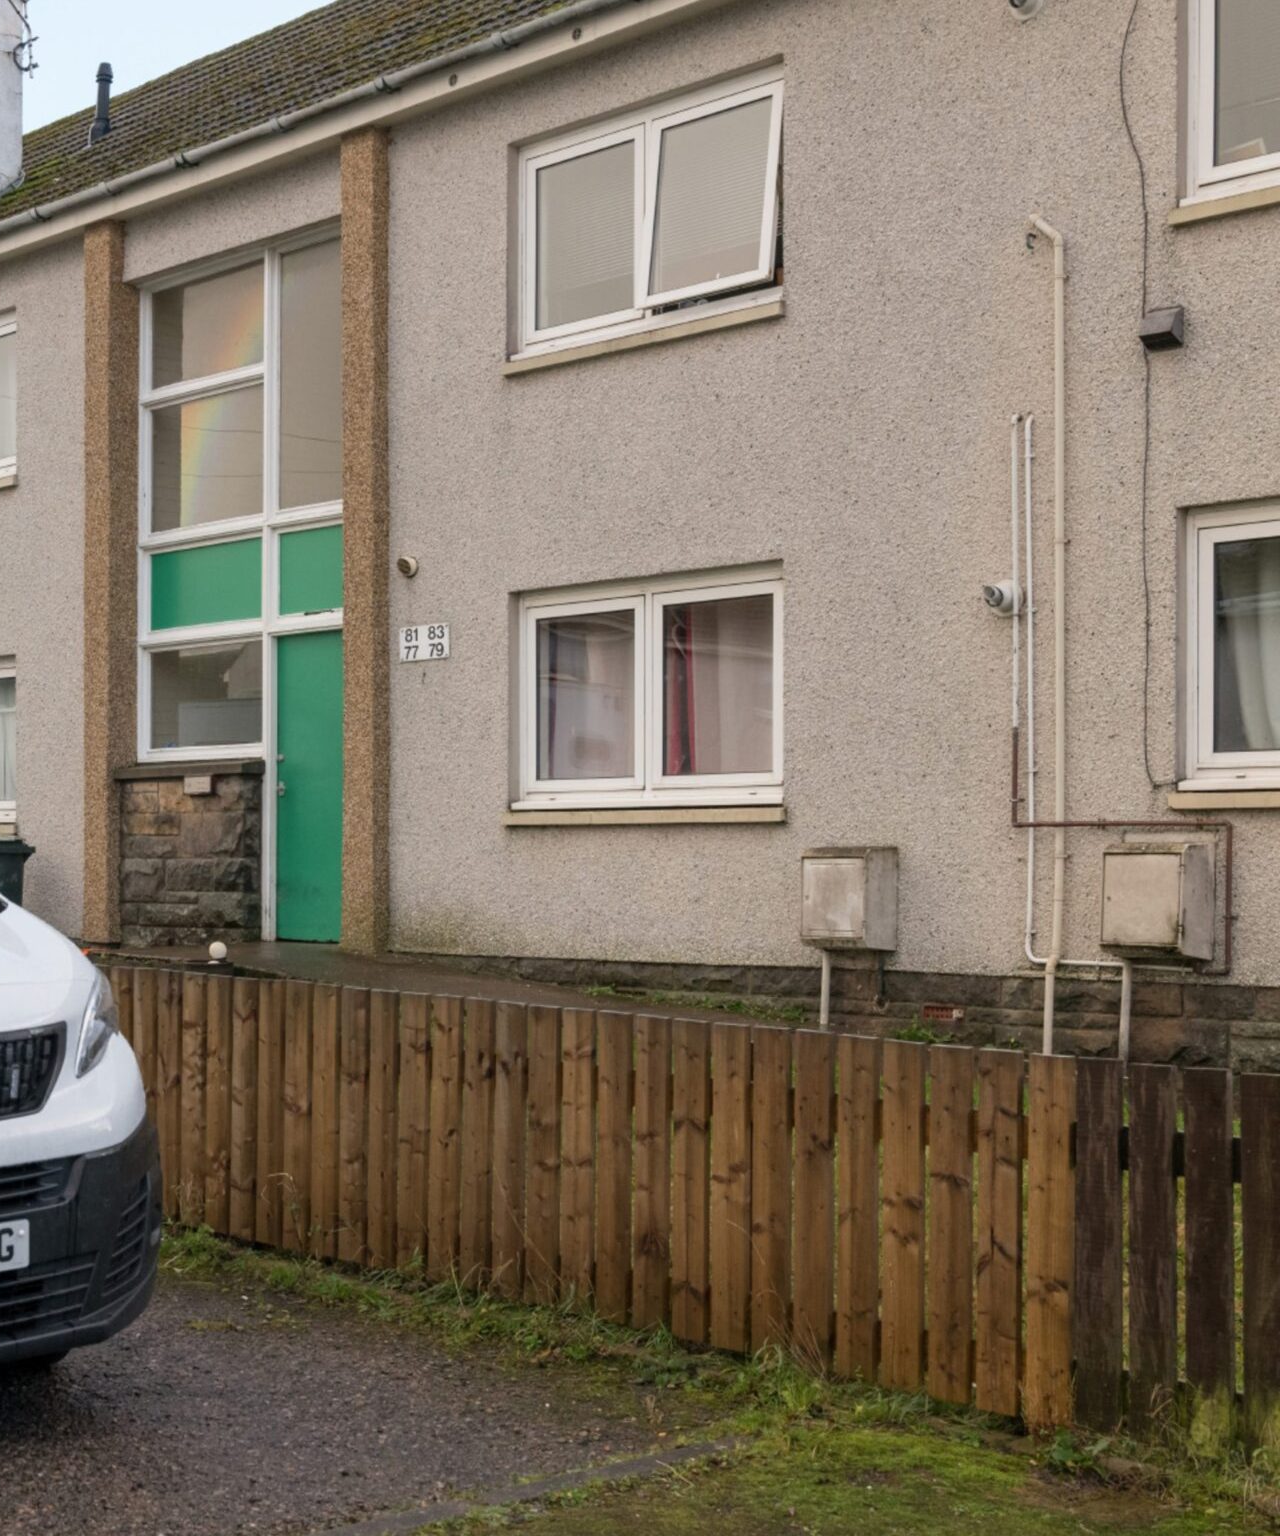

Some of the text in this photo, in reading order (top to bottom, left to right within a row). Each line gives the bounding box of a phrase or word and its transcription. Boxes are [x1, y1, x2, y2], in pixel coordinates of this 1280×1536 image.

[404, 625, 445, 642] 81 83
[404, 643, 445, 660] 77 79
